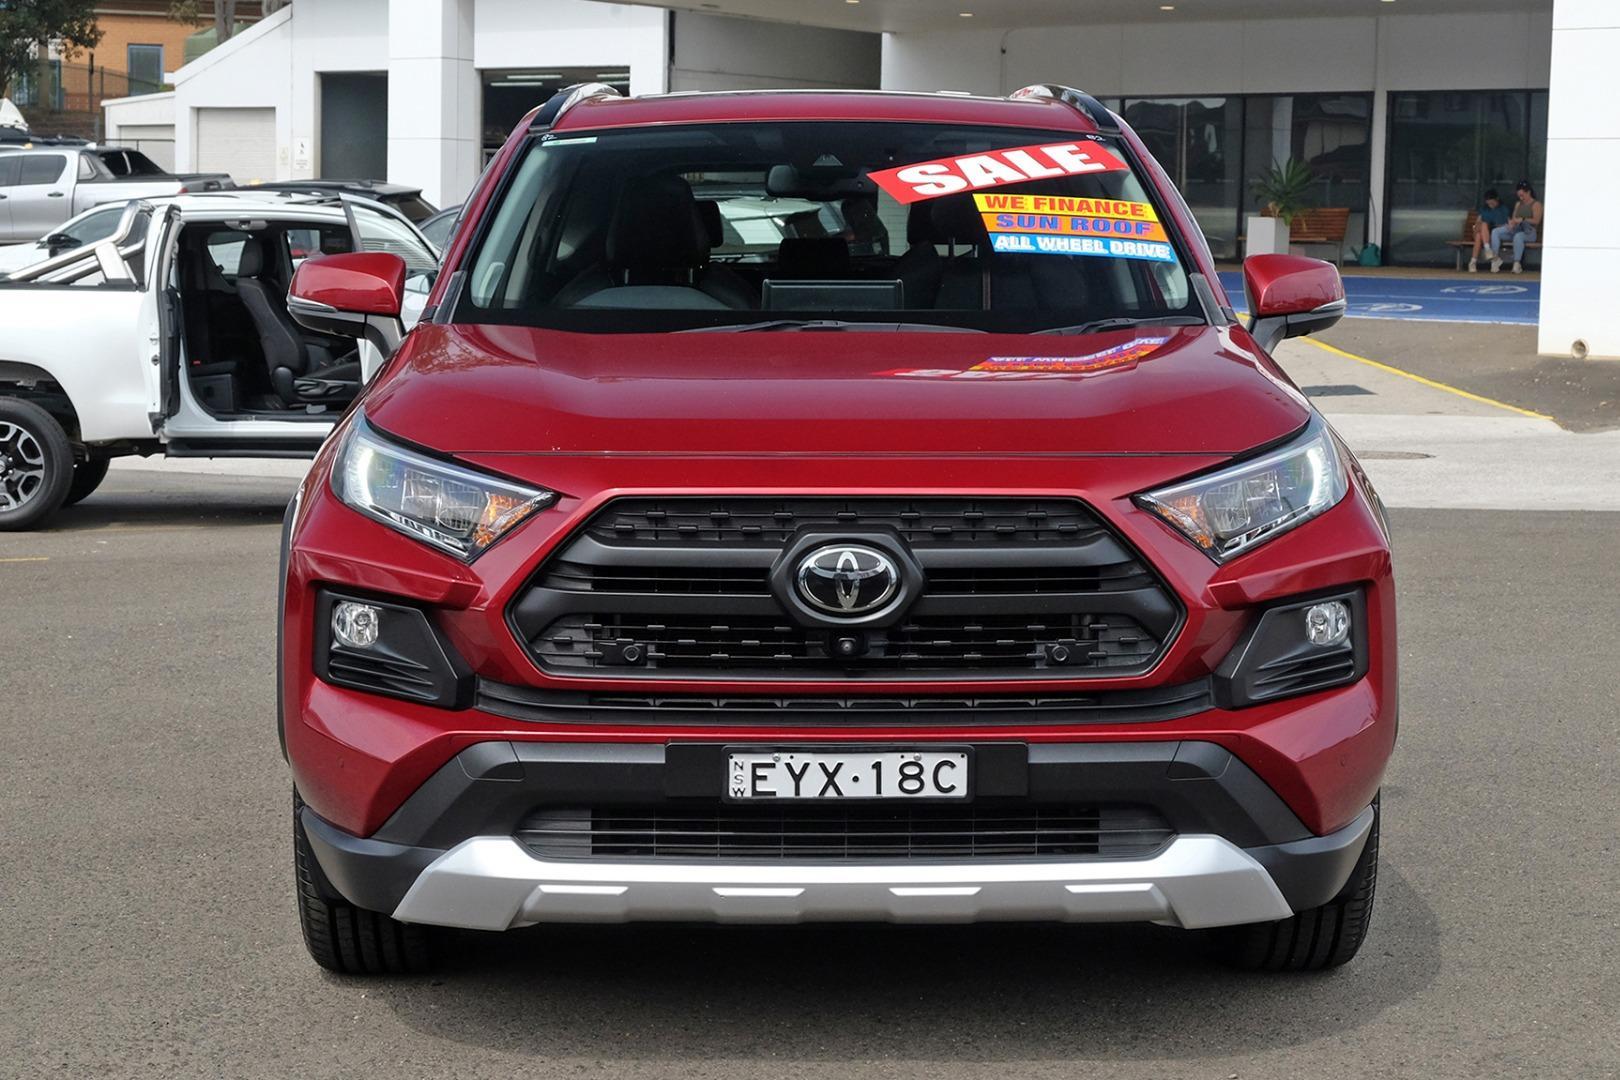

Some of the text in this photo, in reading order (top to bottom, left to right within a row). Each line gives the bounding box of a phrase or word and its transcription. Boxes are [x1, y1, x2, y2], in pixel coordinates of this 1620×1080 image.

[897, 144, 1105, 196] SALE
[985, 195, 1146, 217] WE FINANCE
[996, 215, 1152, 235] SUN ROOF
[994, 235, 1171, 259] ALL WHEEL DRIVE
[731, 761, 746, 798] NSW
